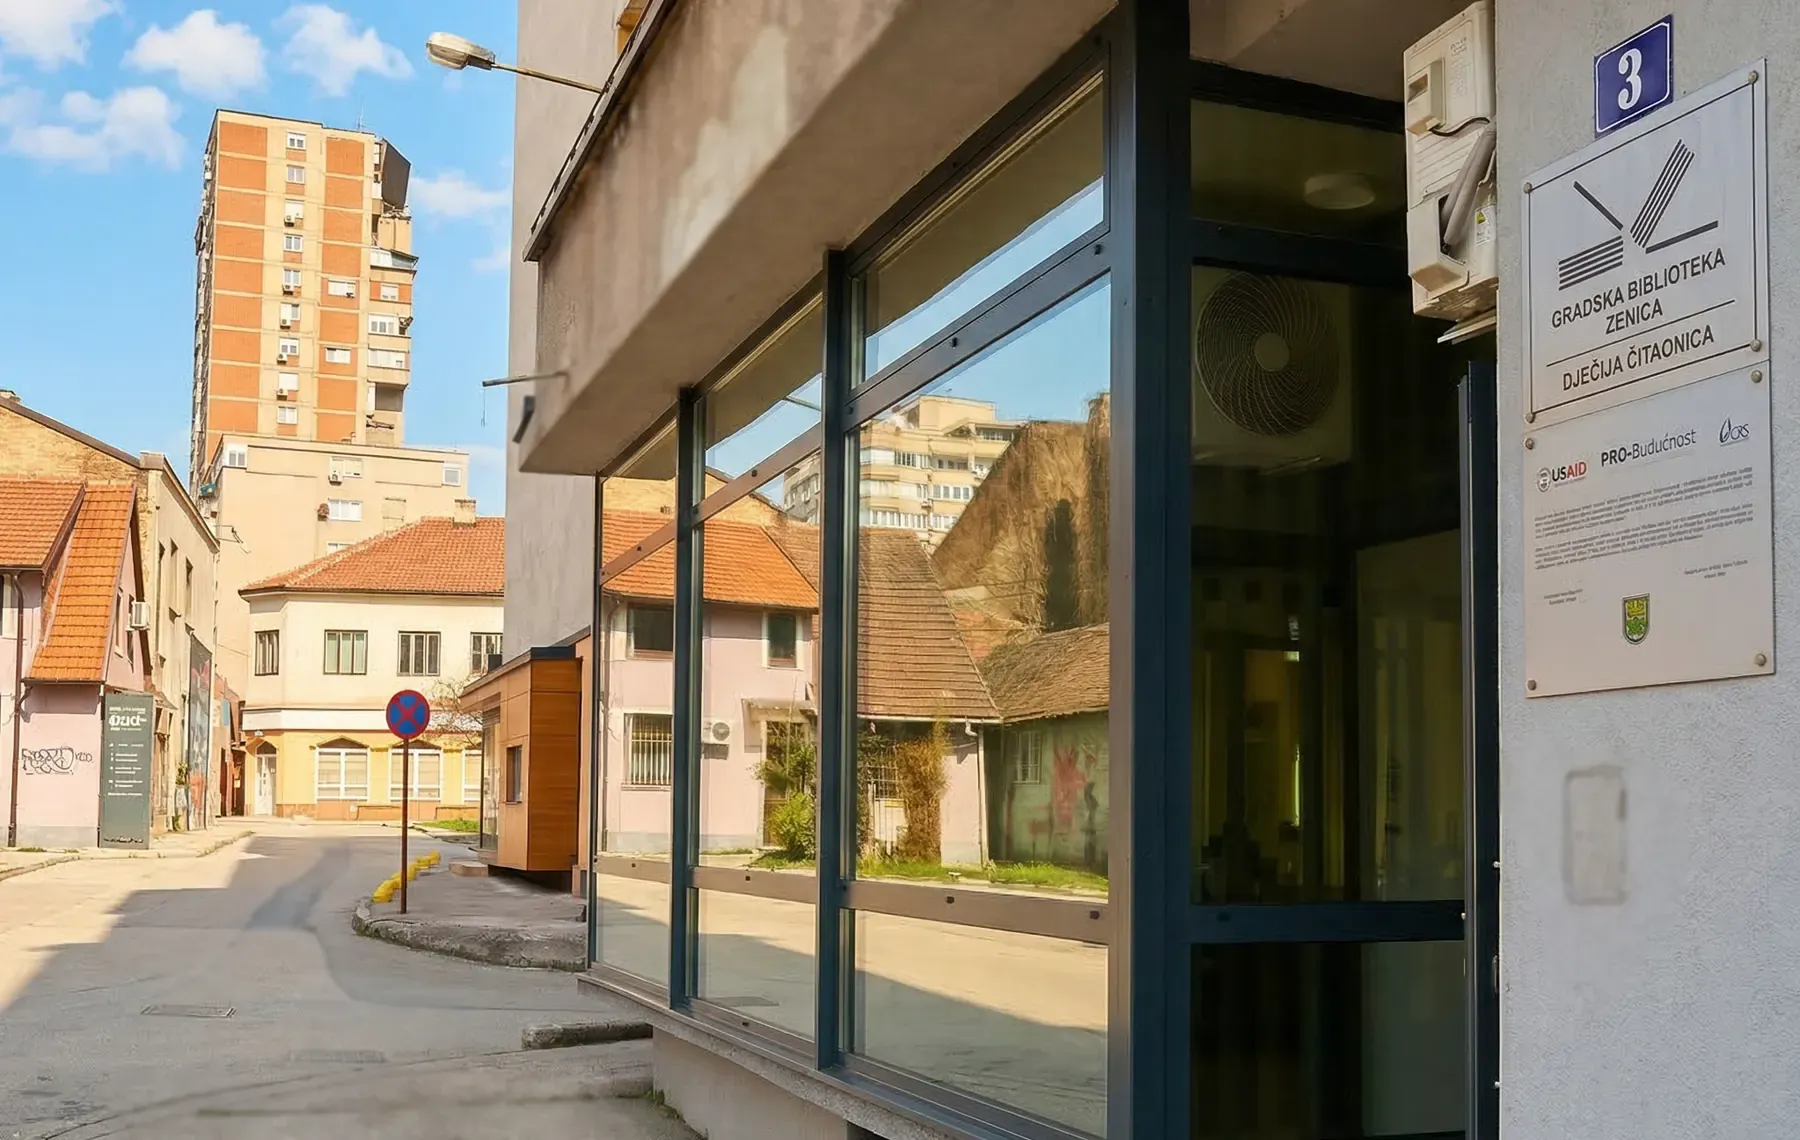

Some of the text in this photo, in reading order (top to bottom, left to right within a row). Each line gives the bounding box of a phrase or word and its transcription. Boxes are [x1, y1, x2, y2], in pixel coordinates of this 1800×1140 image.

[1617, 47, 1642, 111] 3
[1552, 247, 1726, 328] GRADSKA BIBLIOTEKA
[1606, 298, 1663, 335] ZENICA
[1563, 324, 1714, 391] DJEČIJA ČITAONICA
[1552, 461, 1587, 482] USAID
[1601, 429, 1697, 467] PRO-Budućnost
